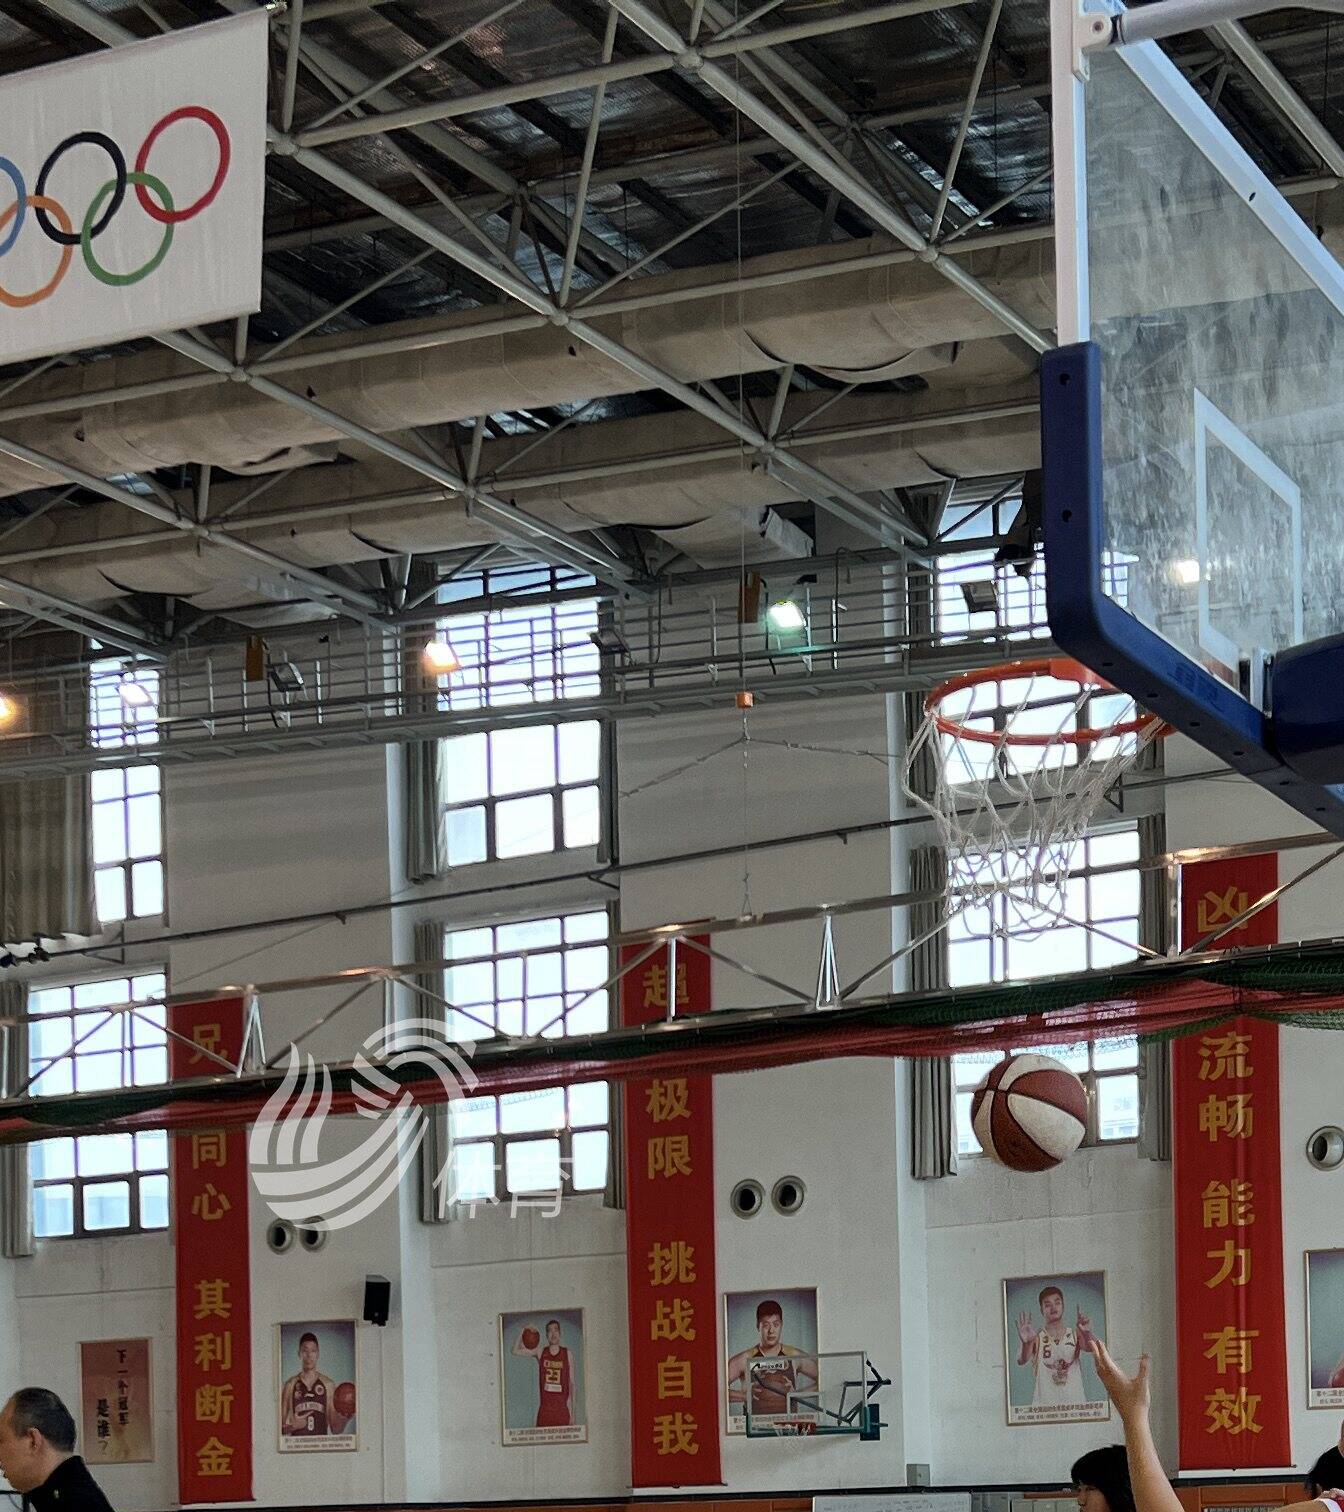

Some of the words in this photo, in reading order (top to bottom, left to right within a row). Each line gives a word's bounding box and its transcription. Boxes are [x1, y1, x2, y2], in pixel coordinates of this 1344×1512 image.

[1198, 1032, 1254, 1141] 流畅
[1201, 1180, 1256, 1288] 能力
[193, 1279, 234, 1477] 其利断金
[648, 1241, 699, 1456] 挑战自我
[1203, 1326, 1263, 1434] 有效
